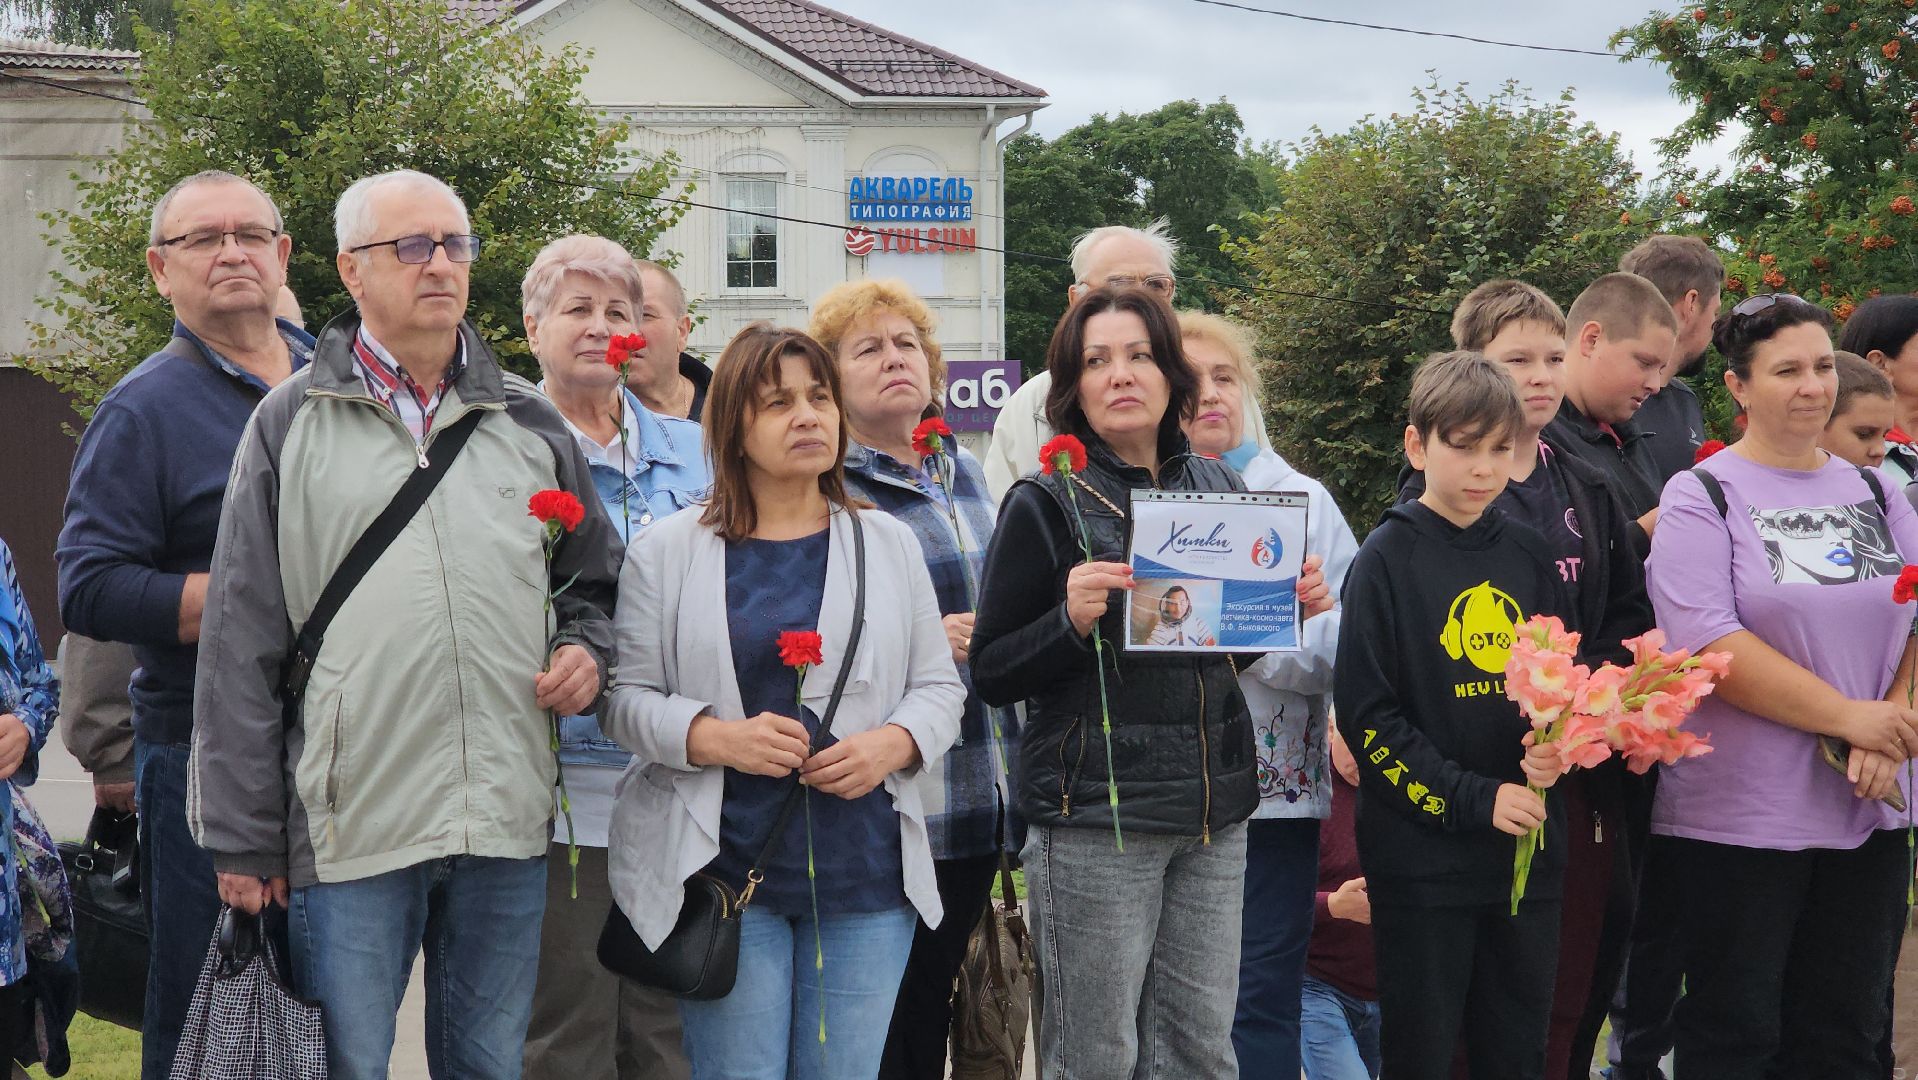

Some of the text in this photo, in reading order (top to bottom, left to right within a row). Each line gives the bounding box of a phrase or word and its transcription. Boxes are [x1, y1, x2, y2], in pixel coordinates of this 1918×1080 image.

[850, 177, 973, 202] АКВАРЕЛЬ
[851, 205, 971, 218] ТИПОГРАФИЯ
[877, 227, 976, 254] YULSUN
[944, 368, 1011, 409] аб
[945, 412, 964, 423] ОР
[1157, 520, 1232, 555] Химки
[1226, 602, 1264, 611] Экскурсия
[1272, 603, 1293, 612] музей
[1238, 622, 1280, 632] Быковского
[1454, 679, 1508, 698] NEW L
